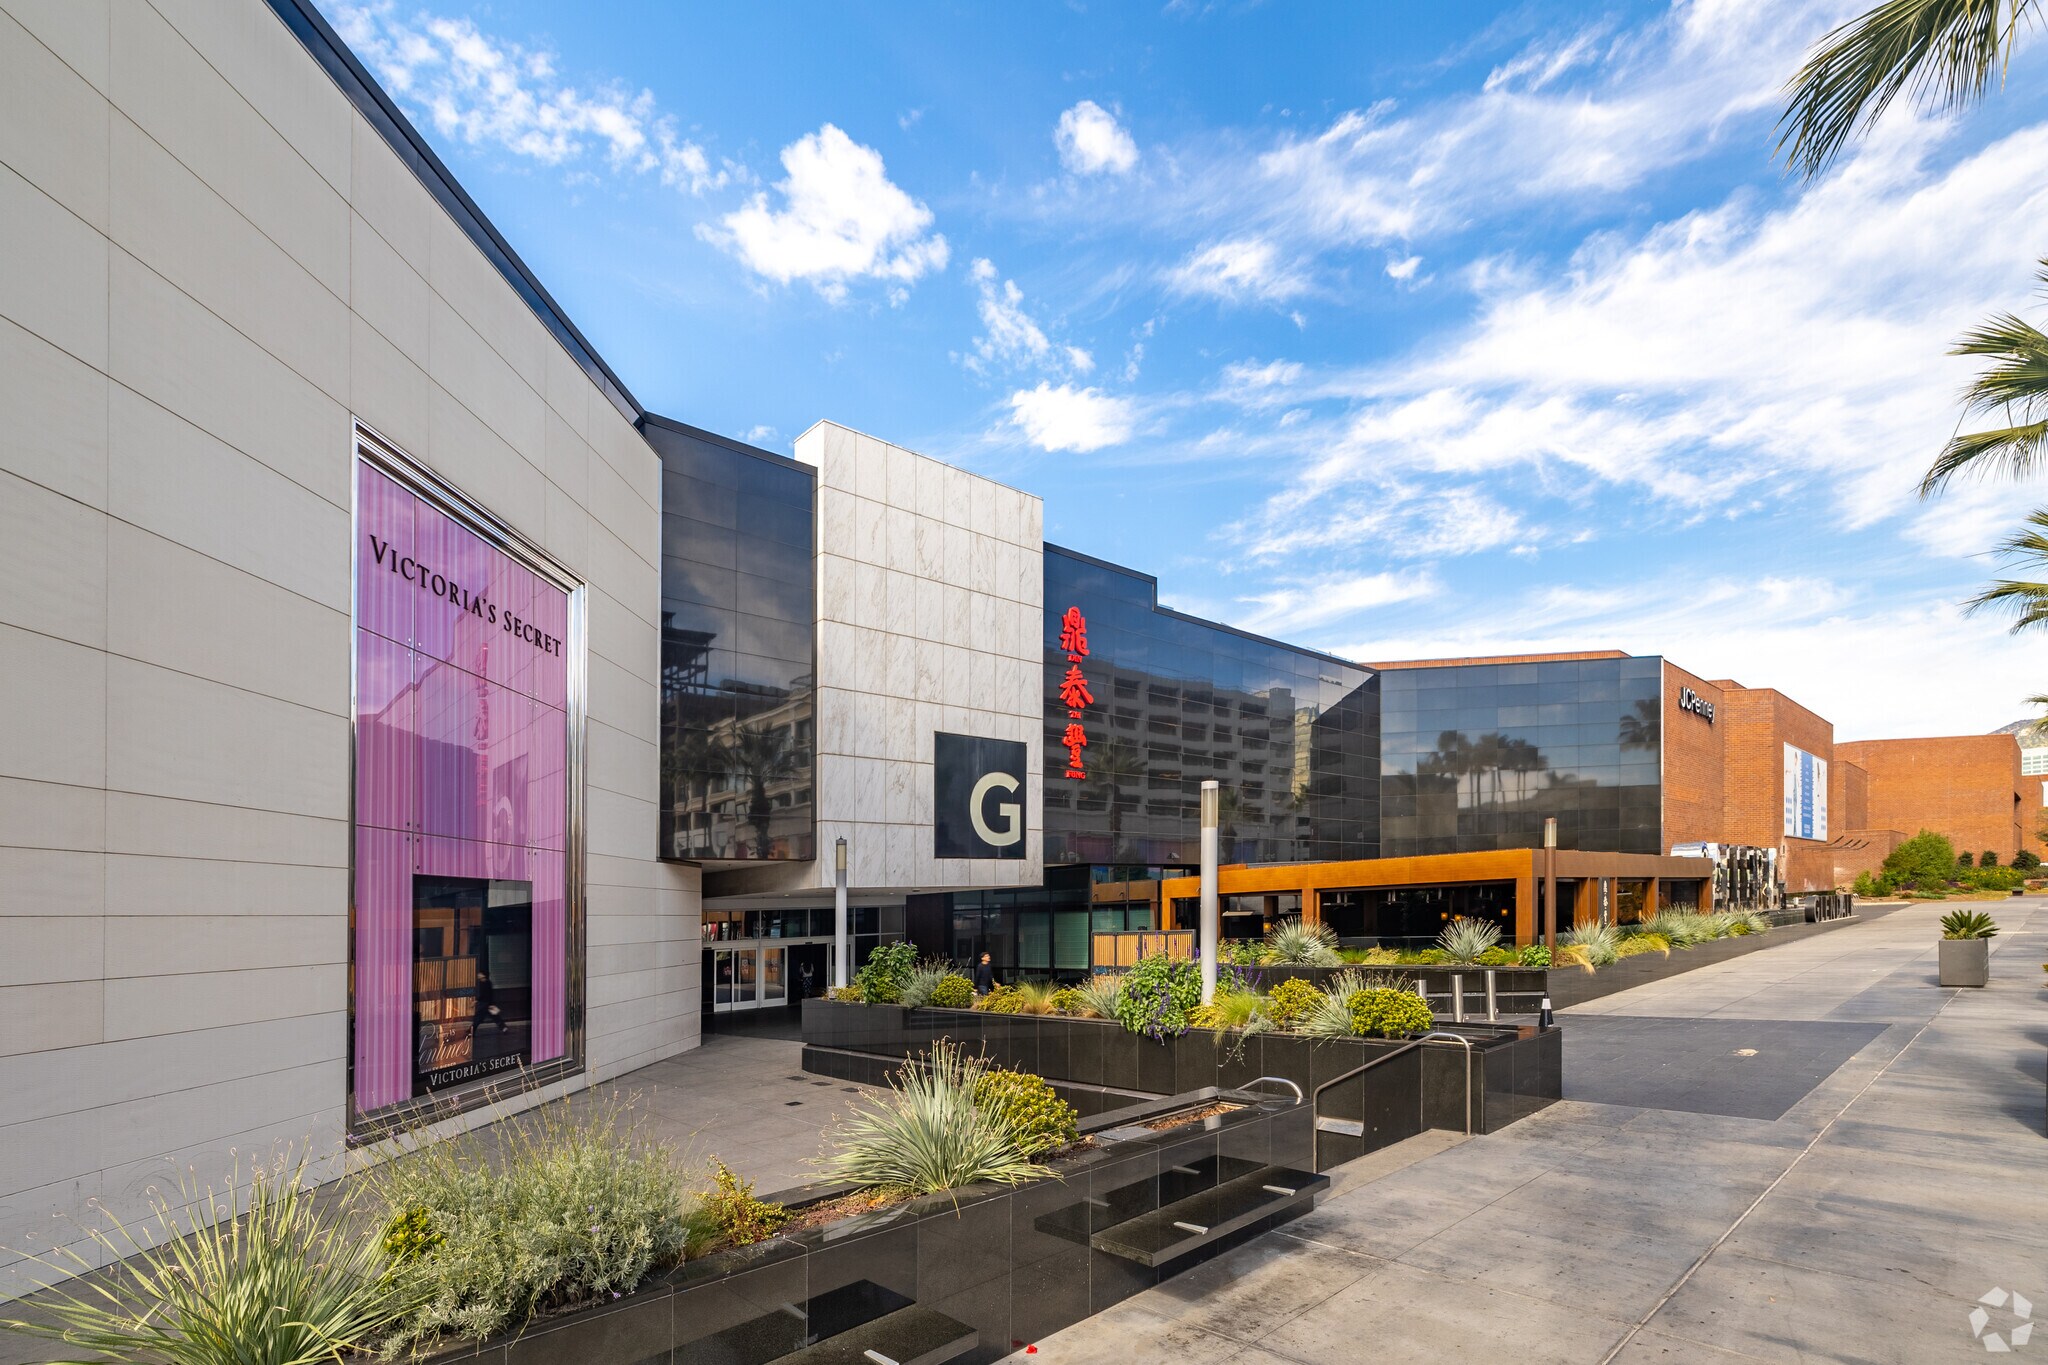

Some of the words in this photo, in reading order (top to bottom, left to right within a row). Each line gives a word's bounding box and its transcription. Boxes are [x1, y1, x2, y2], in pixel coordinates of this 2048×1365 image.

[369, 534, 497, 624] VICTORIA'S
[503, 610, 562, 657] SECRET
[1680, 686, 1716, 724] JCPenney
[1065, 770, 1086, 780] FUNG
[969, 771, 1021, 847] G
[430, 1062, 487, 1086] VICTORIA'S
[489, 1053, 521, 1071] SECRET
